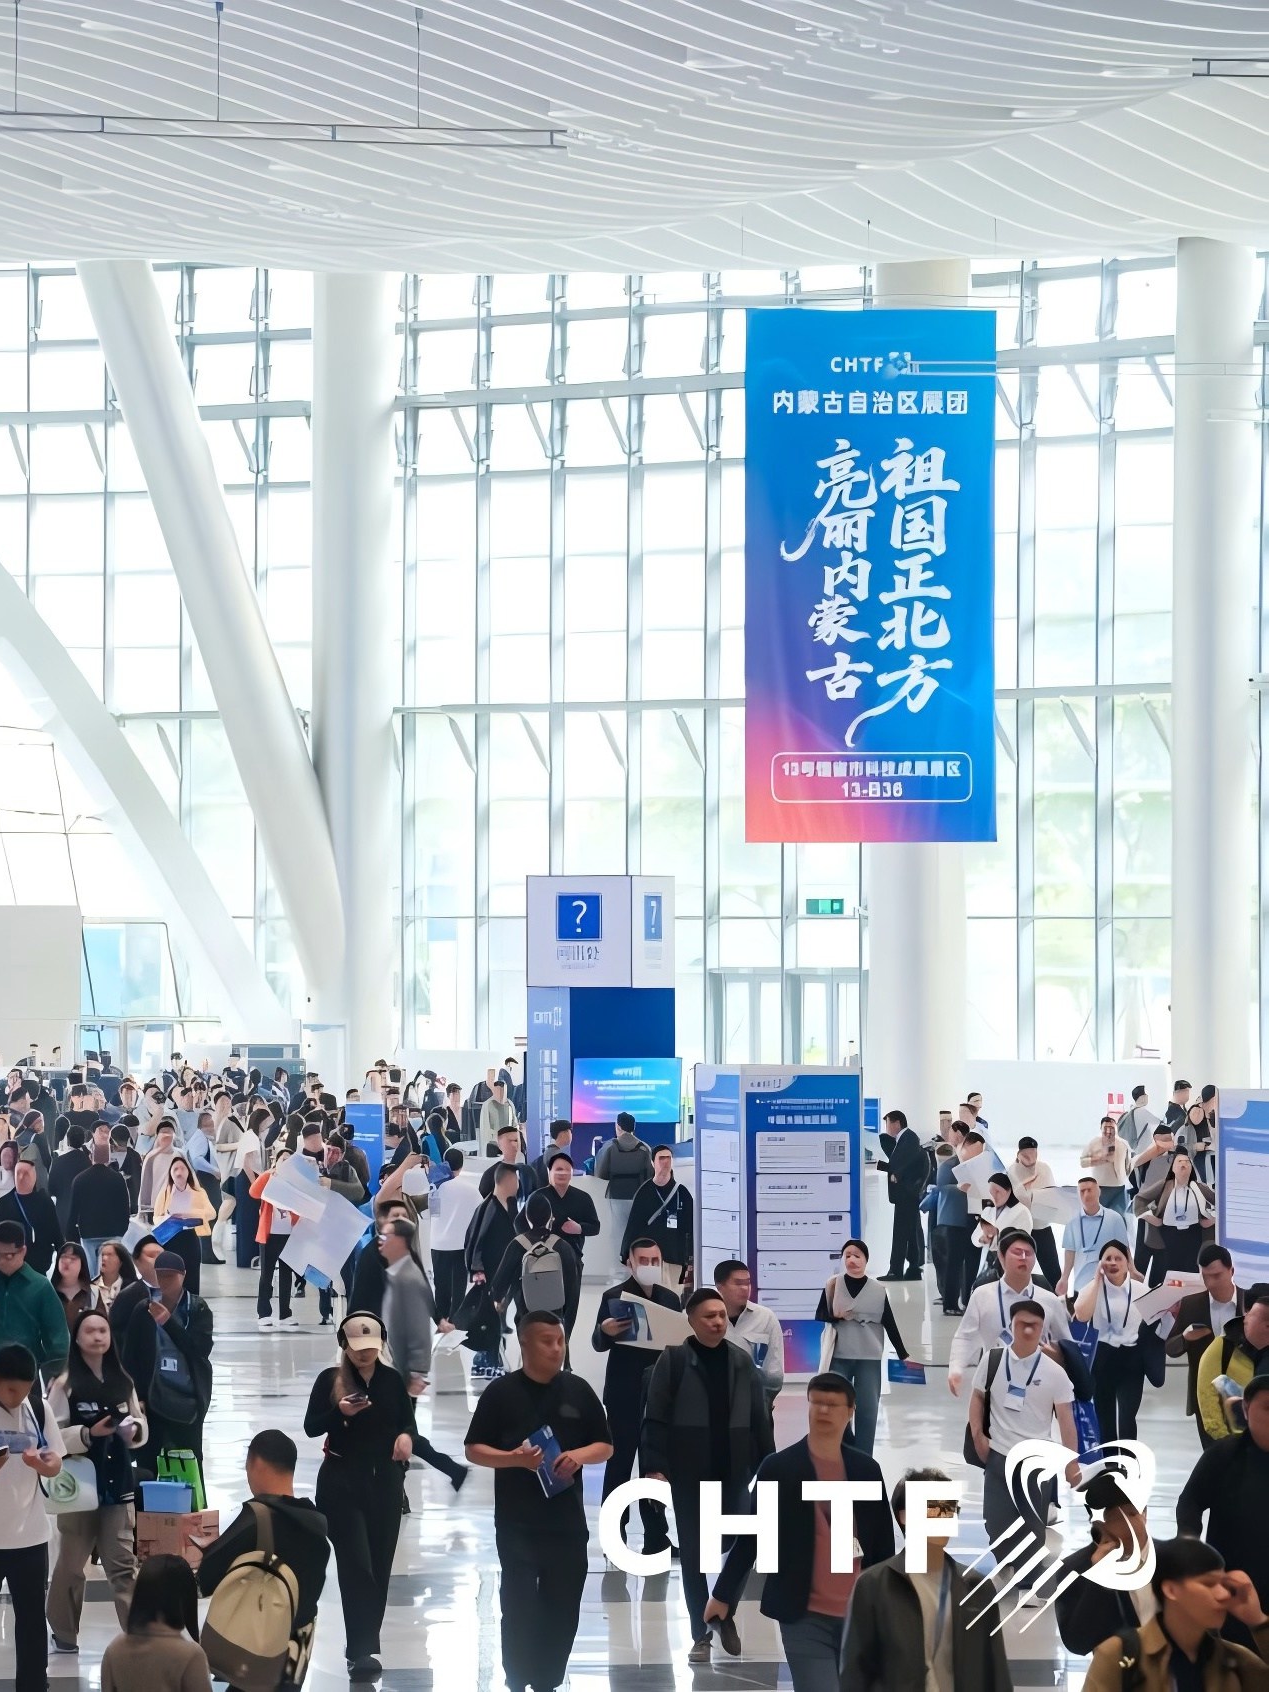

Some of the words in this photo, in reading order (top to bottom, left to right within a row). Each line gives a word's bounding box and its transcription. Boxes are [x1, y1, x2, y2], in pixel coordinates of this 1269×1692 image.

[773, 389, 968, 415] 内蒙古自治区展团
[830, 356, 884, 373] CHTF
[781, 438, 878, 701] 亮丽内蒙古
[845, 437, 961, 748] 祖国正北方
